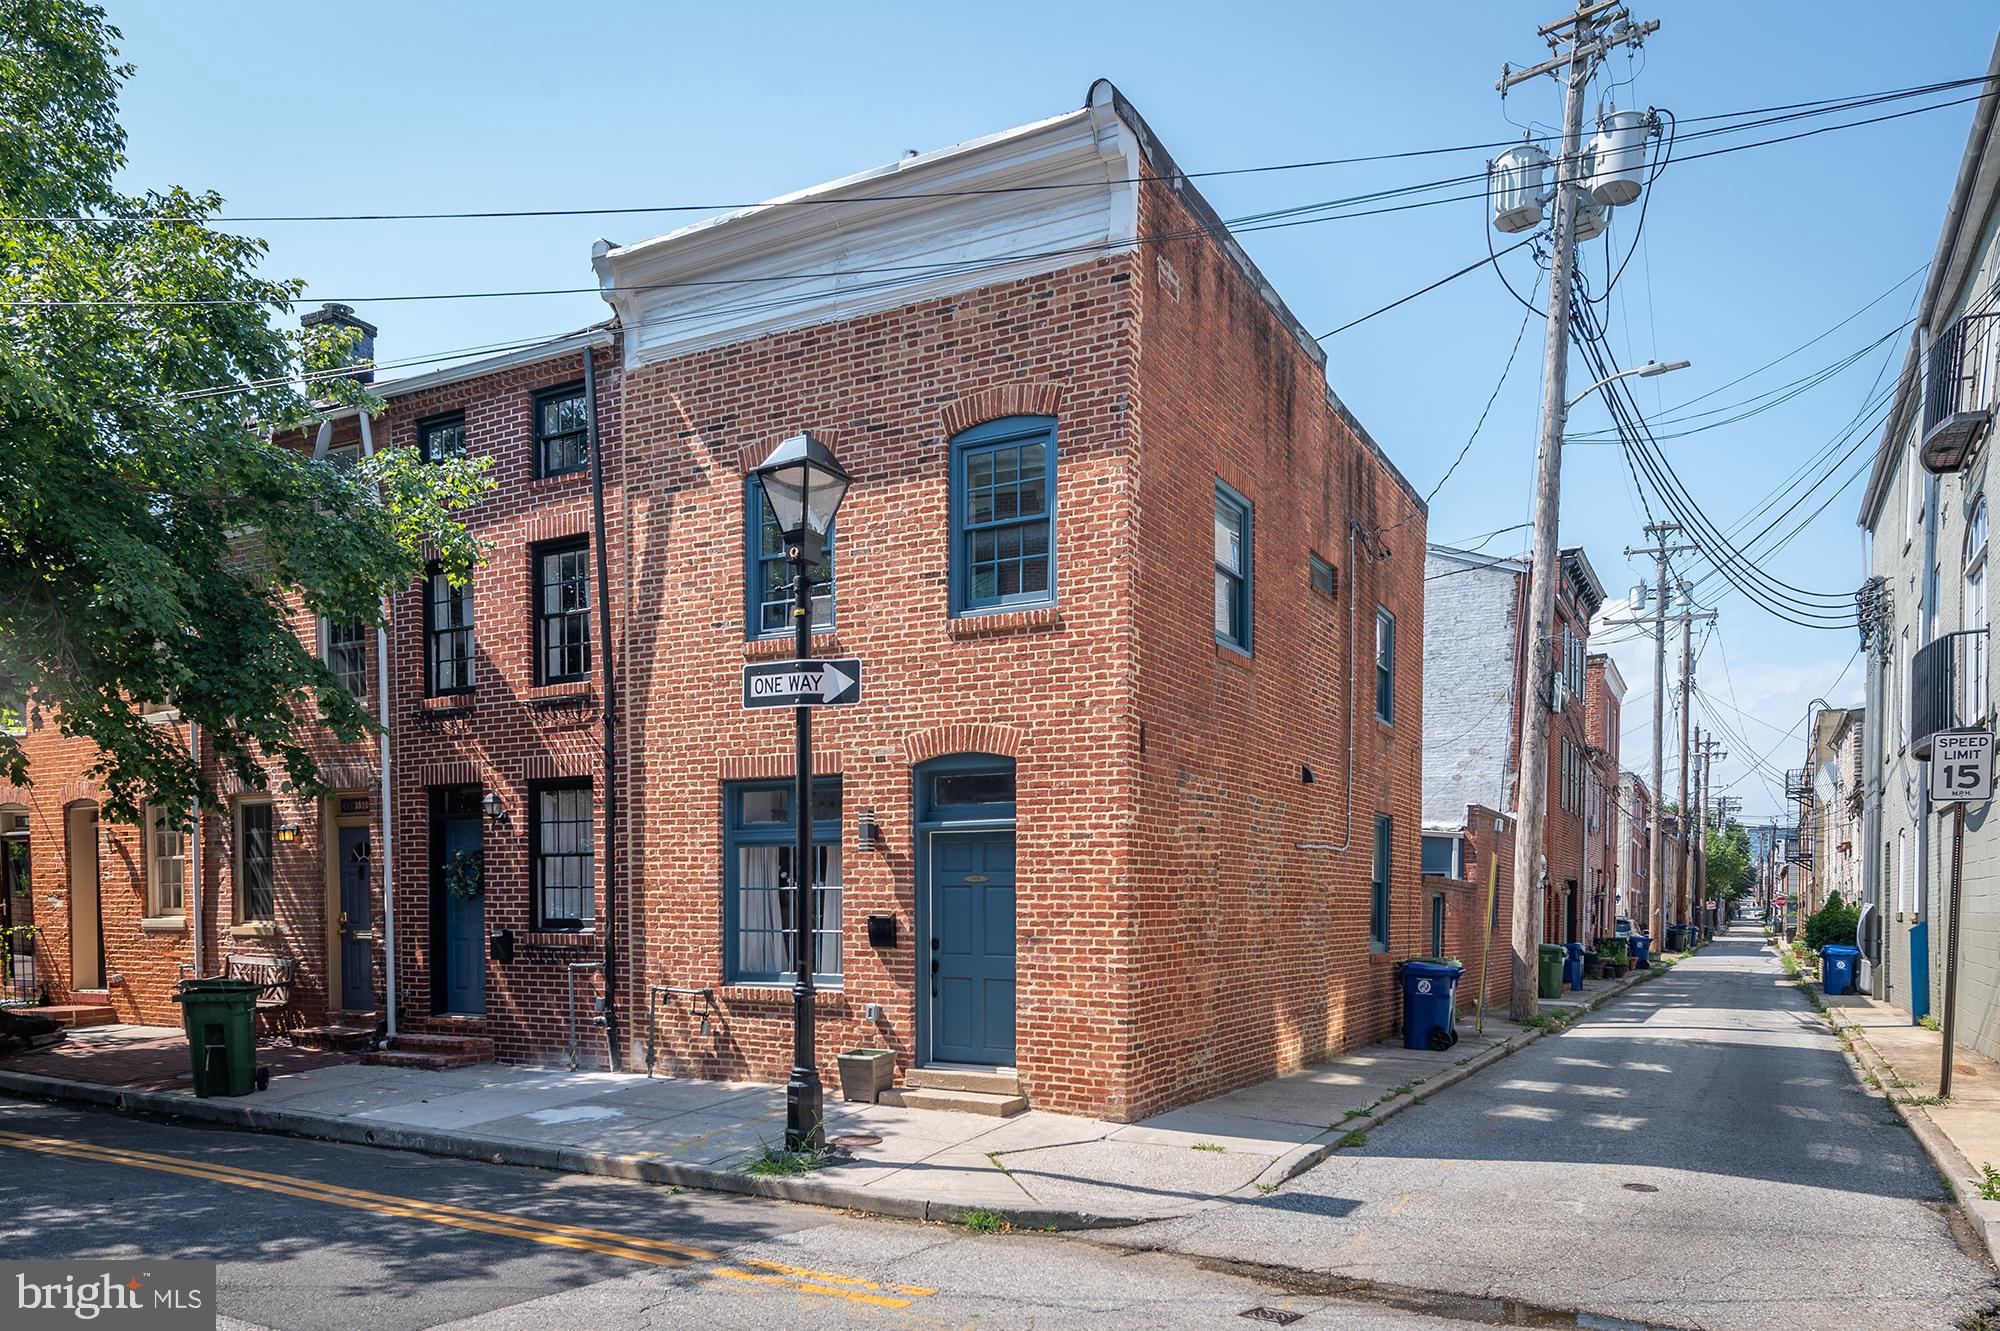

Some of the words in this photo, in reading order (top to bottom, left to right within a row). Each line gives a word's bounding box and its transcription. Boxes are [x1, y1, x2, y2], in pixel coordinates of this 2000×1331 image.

[755, 677, 783, 694] ONE
[789, 674, 823, 692] WAY
[1939, 737, 1989, 748] SPEED
[1944, 749, 1982, 760] LIMIT
[1943, 764, 1981, 789] 15
